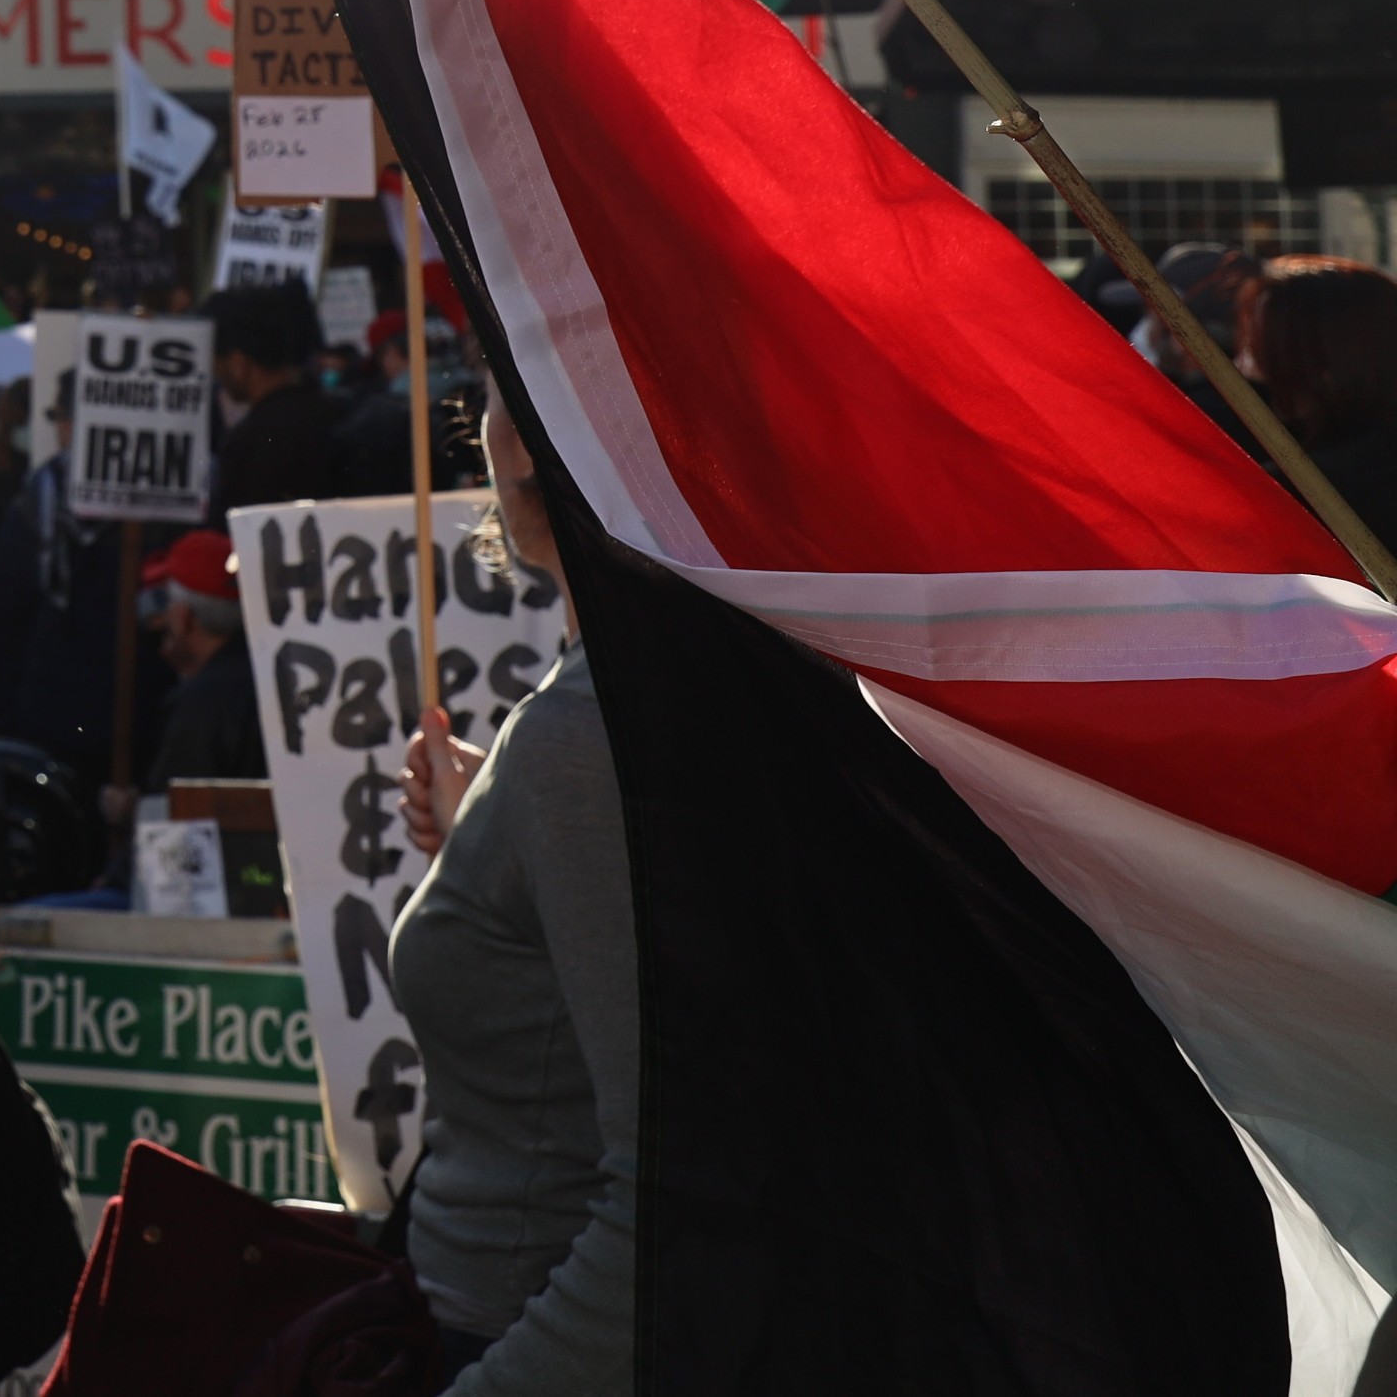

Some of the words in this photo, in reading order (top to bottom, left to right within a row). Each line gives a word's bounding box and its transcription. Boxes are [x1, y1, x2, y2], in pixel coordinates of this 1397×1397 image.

[86, 424, 193, 490] IRAN
[274, 628, 567, 756] Pales
[18, 973, 140, 1058] Pike
[161, 984, 316, 1071] Place
[58, 1119, 107, 1180] ar
[199, 1113, 330, 1201] Grill
